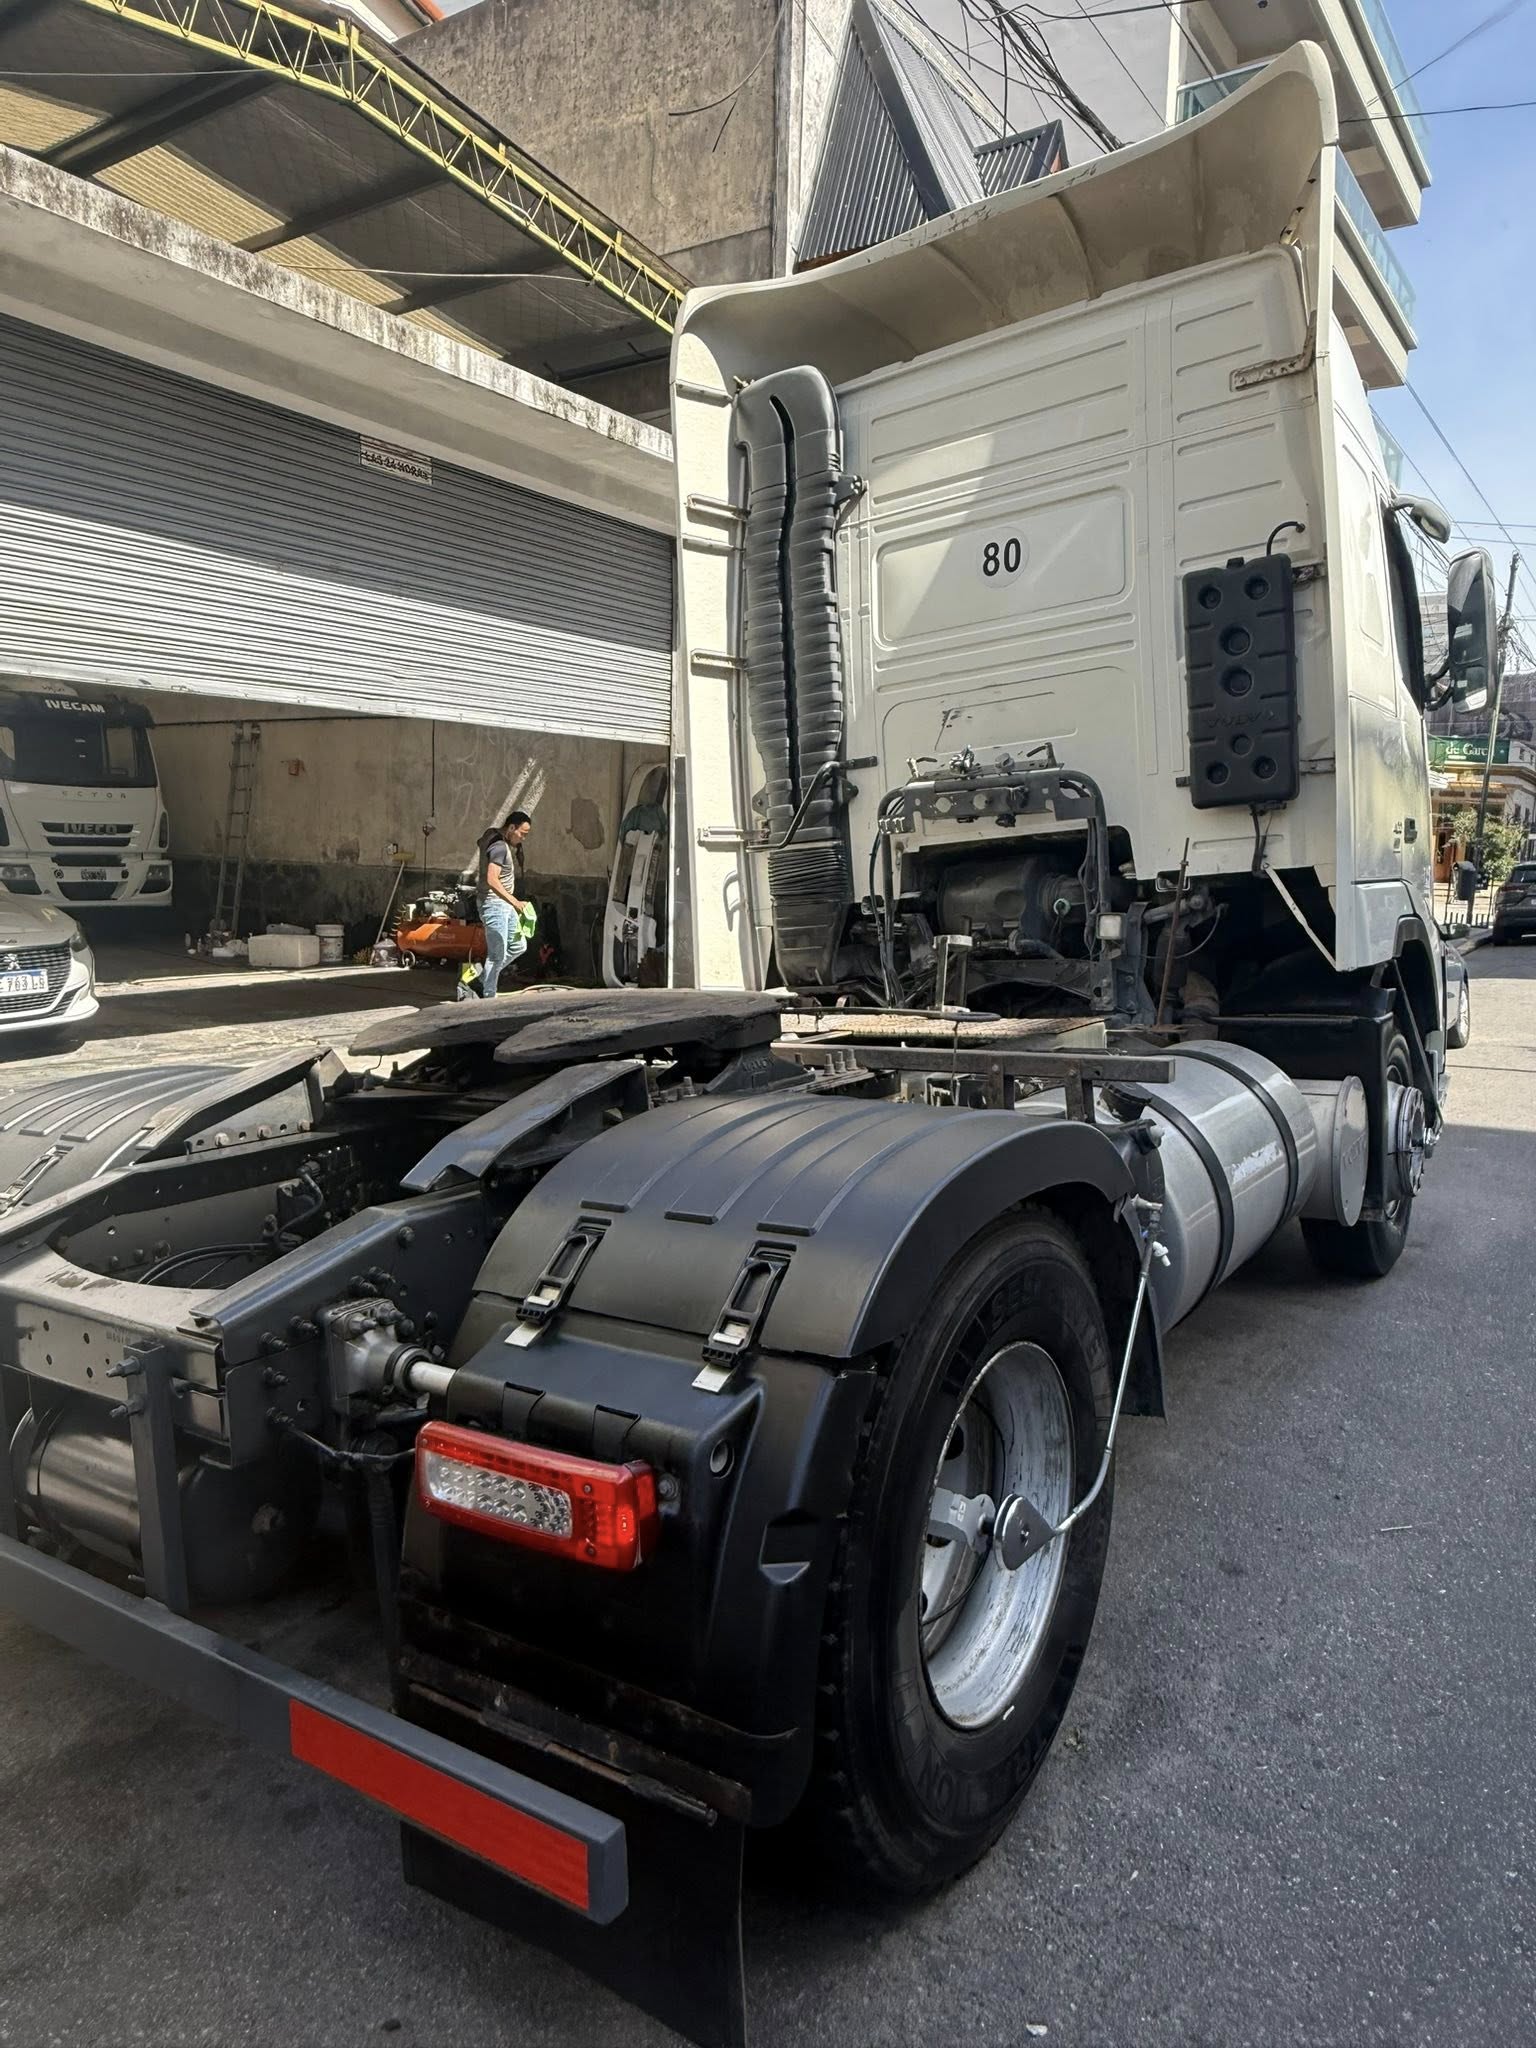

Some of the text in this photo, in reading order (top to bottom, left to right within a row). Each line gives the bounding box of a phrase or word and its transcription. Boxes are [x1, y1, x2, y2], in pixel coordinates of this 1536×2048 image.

[983, 538, 1021, 576] 80
[45, 699, 106, 713] IVECAM
[1446, 741, 1494, 756] de Garc
[64, 823, 117, 834] IVECO
